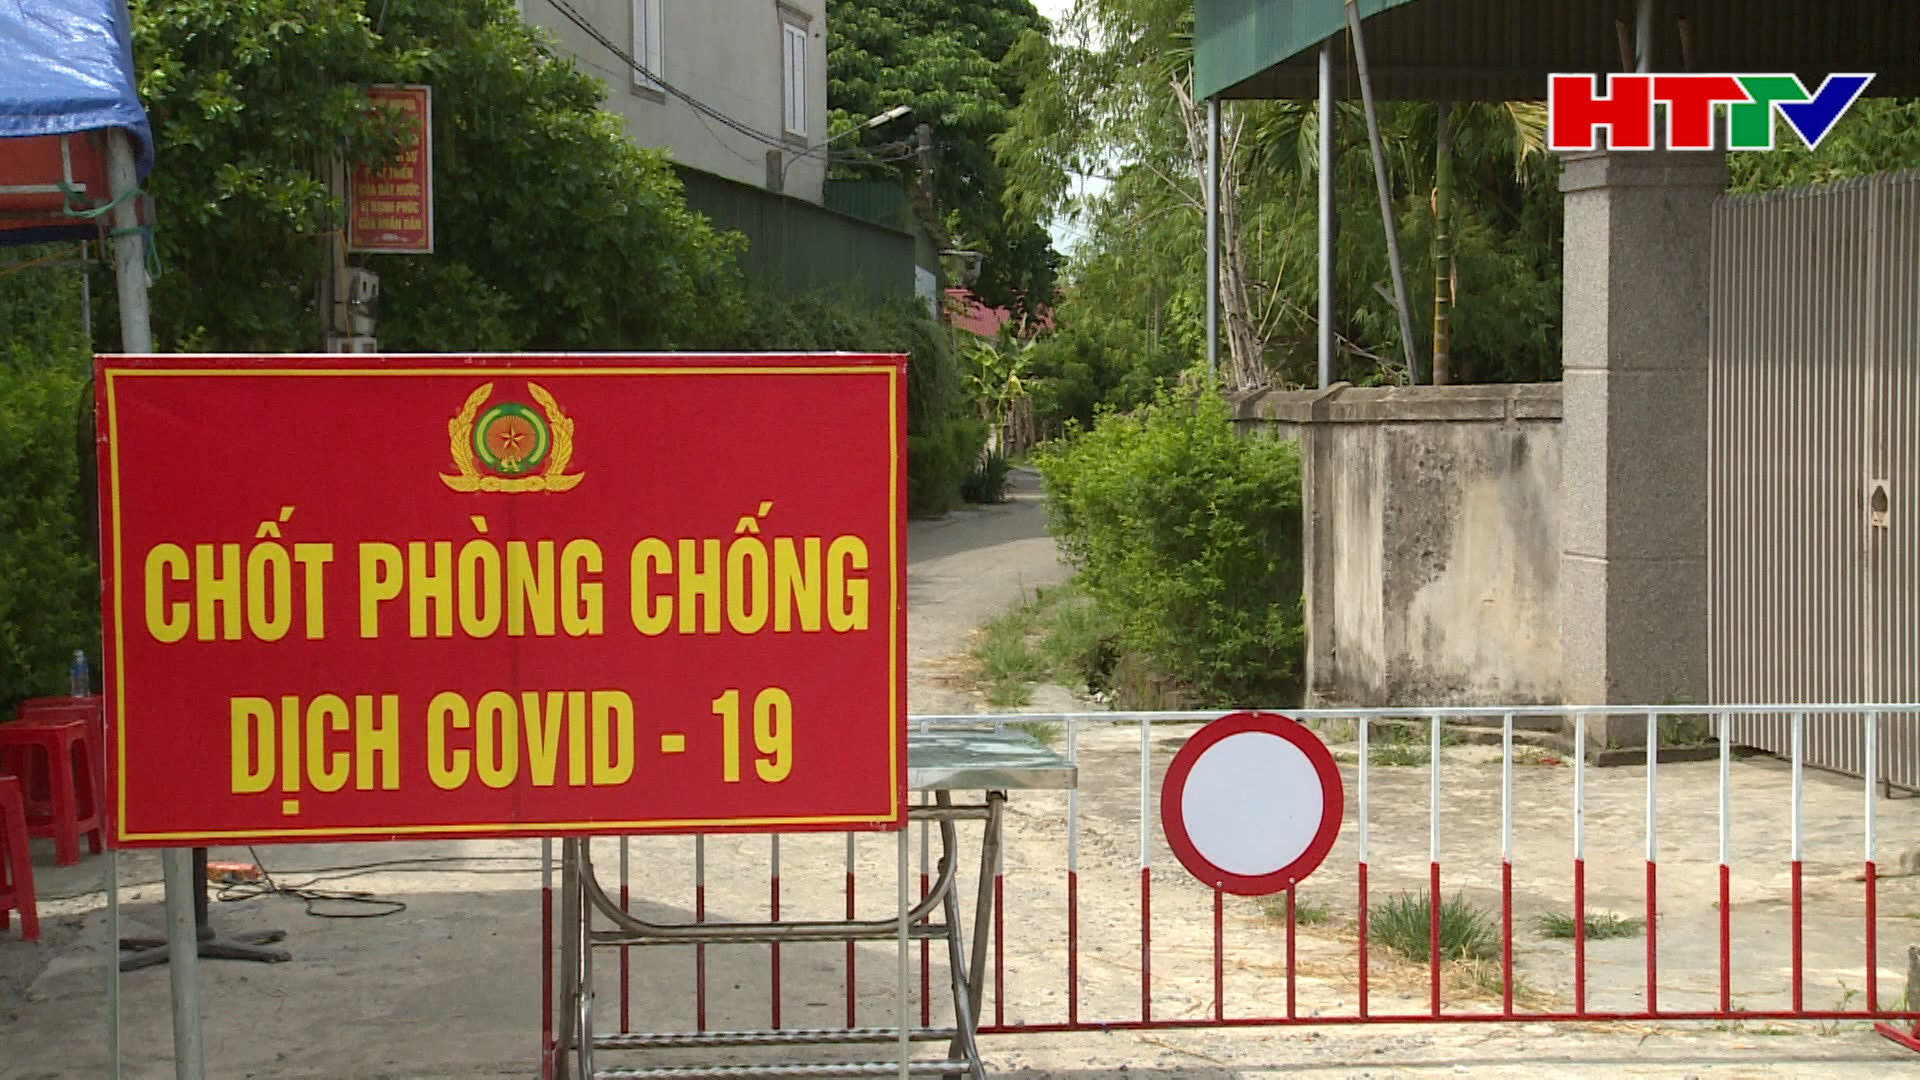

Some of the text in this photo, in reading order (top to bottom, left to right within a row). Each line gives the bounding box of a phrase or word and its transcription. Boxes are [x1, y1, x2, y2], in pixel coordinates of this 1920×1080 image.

[144, 500, 870, 643] CHỐT PHÒNG CHỐNG
[230, 686, 794, 816] DỊCH COVID - 19
